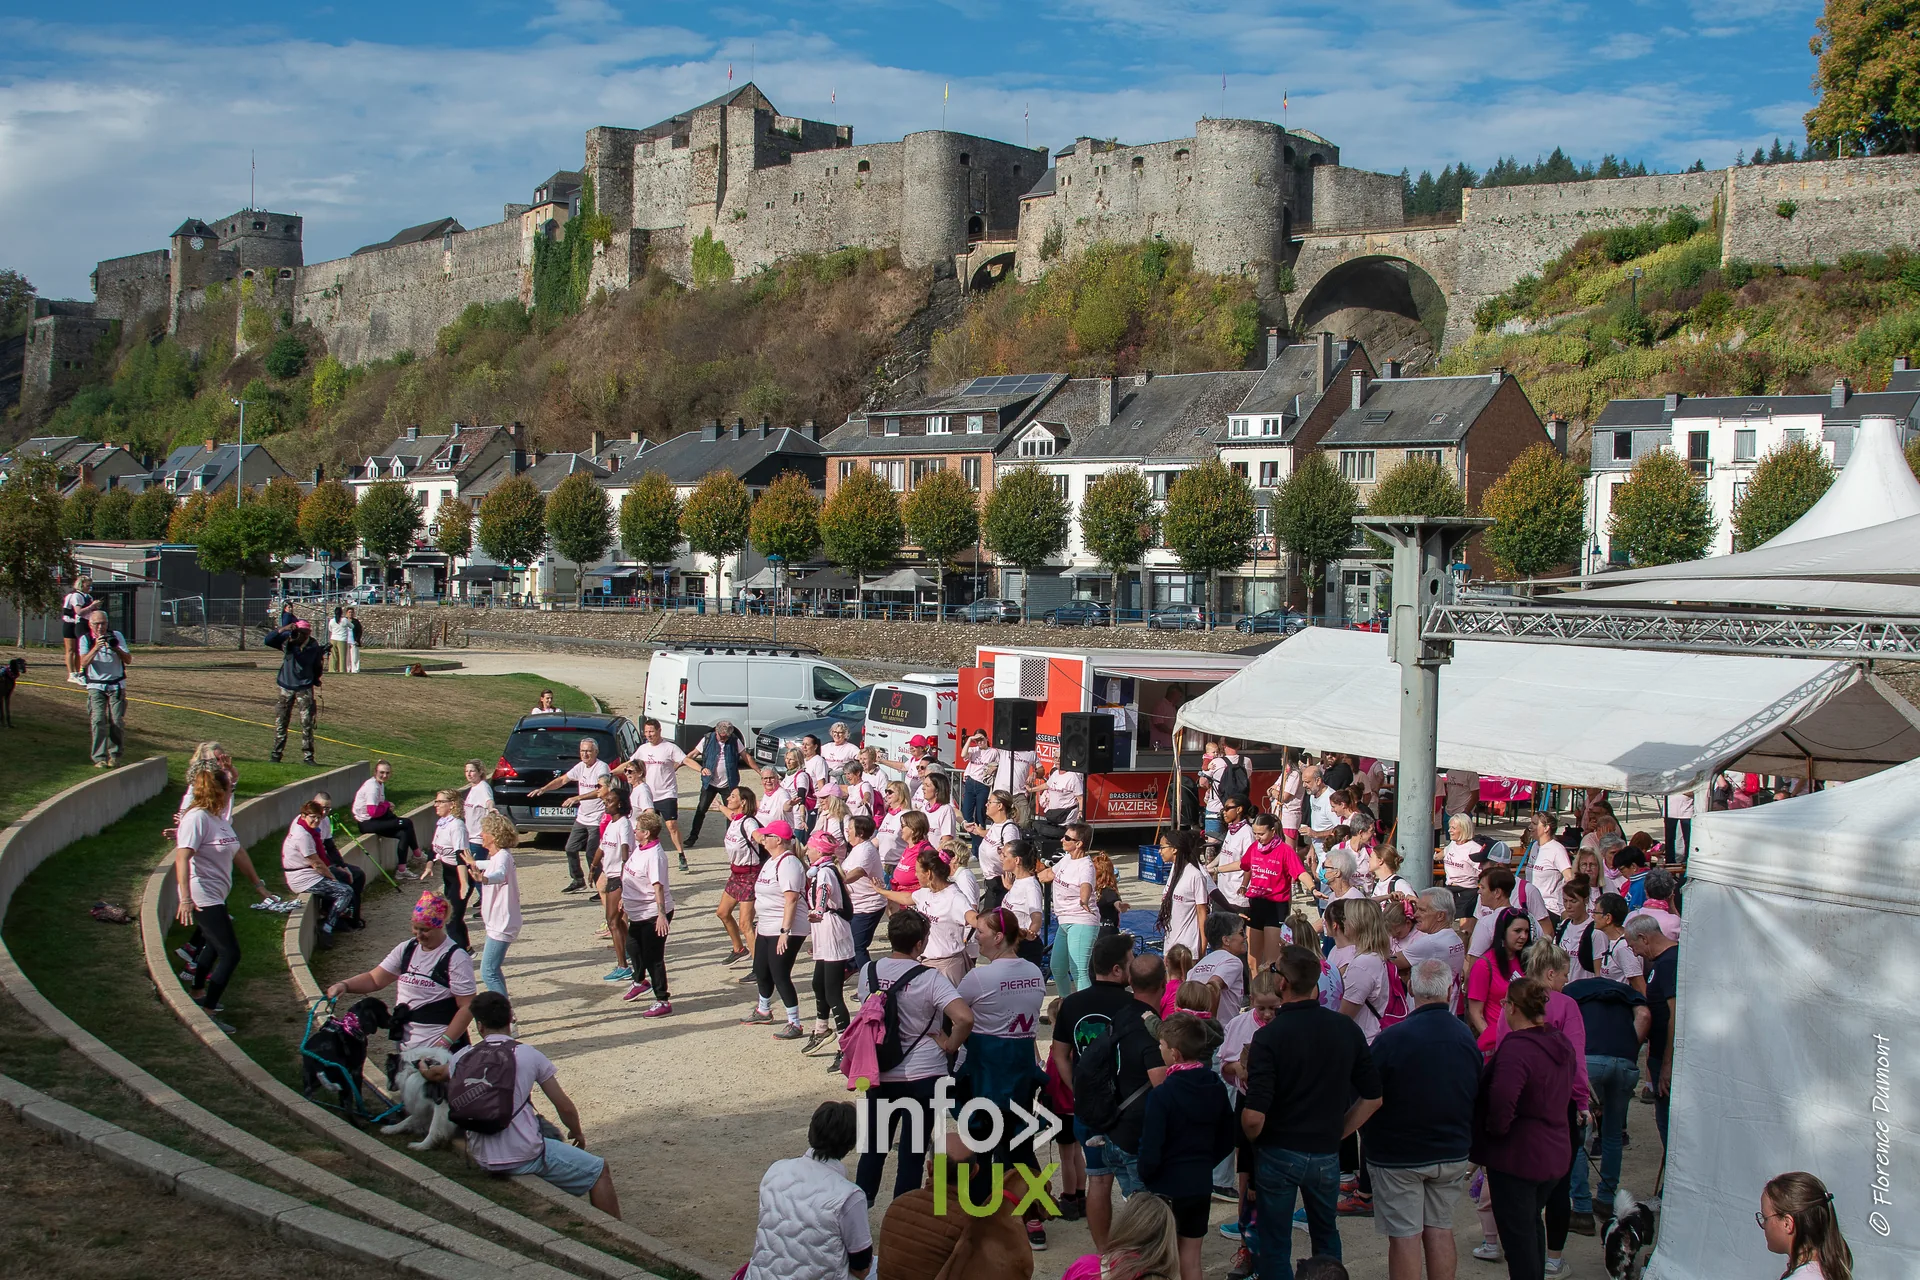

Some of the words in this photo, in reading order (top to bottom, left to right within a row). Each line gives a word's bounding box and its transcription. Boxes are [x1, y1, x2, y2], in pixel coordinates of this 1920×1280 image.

[888, 708, 909, 718] FUMET
[1108, 801, 1158, 811] MAZIERS
[420, 979, 436, 987] ROSE
[1000, 978, 1041, 991] PIERRET
